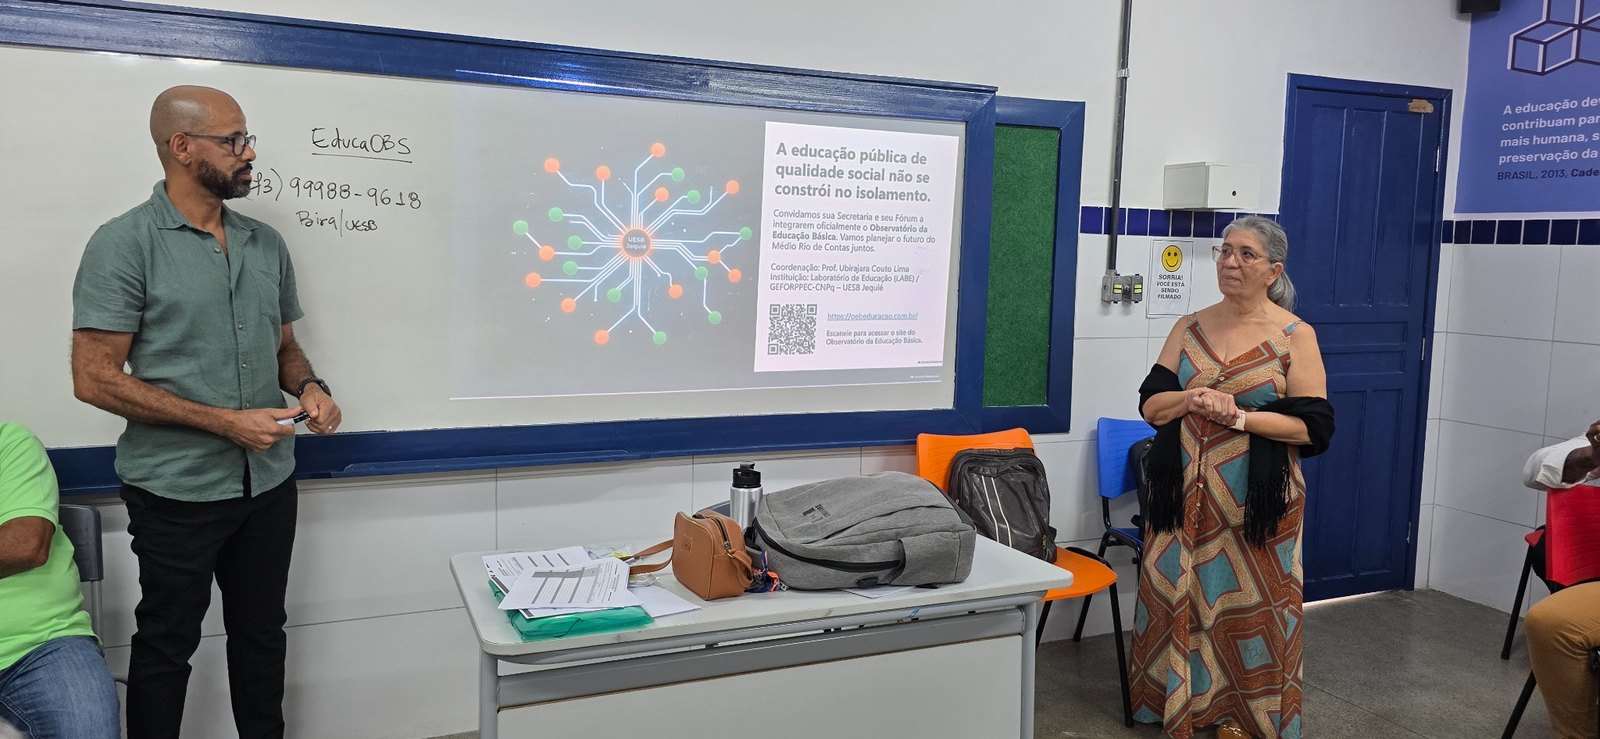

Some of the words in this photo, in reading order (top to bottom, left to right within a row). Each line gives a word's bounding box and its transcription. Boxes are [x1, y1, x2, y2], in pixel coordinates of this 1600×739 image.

[1503, 105, 1512, 115] A
[1515, 99, 1578, 114] educação
[1502, 118, 1575, 131] contribuam
[311, 127, 411, 154] EducaOBS
[1500, 136, 1530, 147] mais
[1532, 133, 1589, 145] humana,
[776, 142, 787, 156] A
[791, 144, 856, 162] educação
[860, 149, 907, 164] pública
[911, 152, 928, 165] de
[1498, 149, 1578, 166] preservação
[1581, 148, 1598, 158] da
[775, 163, 845, 179] qualidade
[848, 168, 885, 182] social
[888, 170, 913, 183] não
[916, 173, 930, 184] se
[1497, 170, 1538, 180] BRASIL,
[1540, 169, 1568, 178] 2013,
[290, 176, 422, 210] 99988-9618
[774, 184, 831, 198] constrói
[834, 188, 853, 198] no
[856, 186, 931, 202] isolamento.
[773, 209, 820, 219] Convidamos
[822, 212, 835, 220] sua
[837, 212, 872, 222] Secretaria
[894, 213, 918, 222] Fórum
[772, 220, 814, 231] integrarem
[816, 222, 862, 231] oficialmente
[870, 224, 917, 233] Observatório
[918, 225, 928, 233] da
[772, 231, 810, 242] Educação
[812, 232, 838, 241] Básica.
[840, 233, 864, 242] Vamos
[866, 234, 895, 244] planejar
[902, 234, 924, 243] futuro
[926, 235, 936, 244] do
[772, 242, 797, 250] Médio
[798, 242, 812, 251] Rio
[813, 243, 822, 251] de
[824, 244, 850, 252] Contas
[850, 244, 876, 253] juntos.
[770, 262, 820, 273] Coordenação:
[822, 264, 838, 272] Prof.
[840, 264, 870, 274] Ubirajara
[872, 264, 892, 273] Couto
[770, 274, 809, 284] Instituição:
[810, 274, 850, 282] Laboratório
[851, 274, 860, 282] de
[861, 274, 892, 284] Educação
[894, 274, 914, 284] (LABE)
[770, 283, 835, 292] GEFORPPEC-CNPq
[842, 283, 860, 292] UESB
[861, 284, 884, 292] Jequié
[874, 337, 902, 346] Educação
